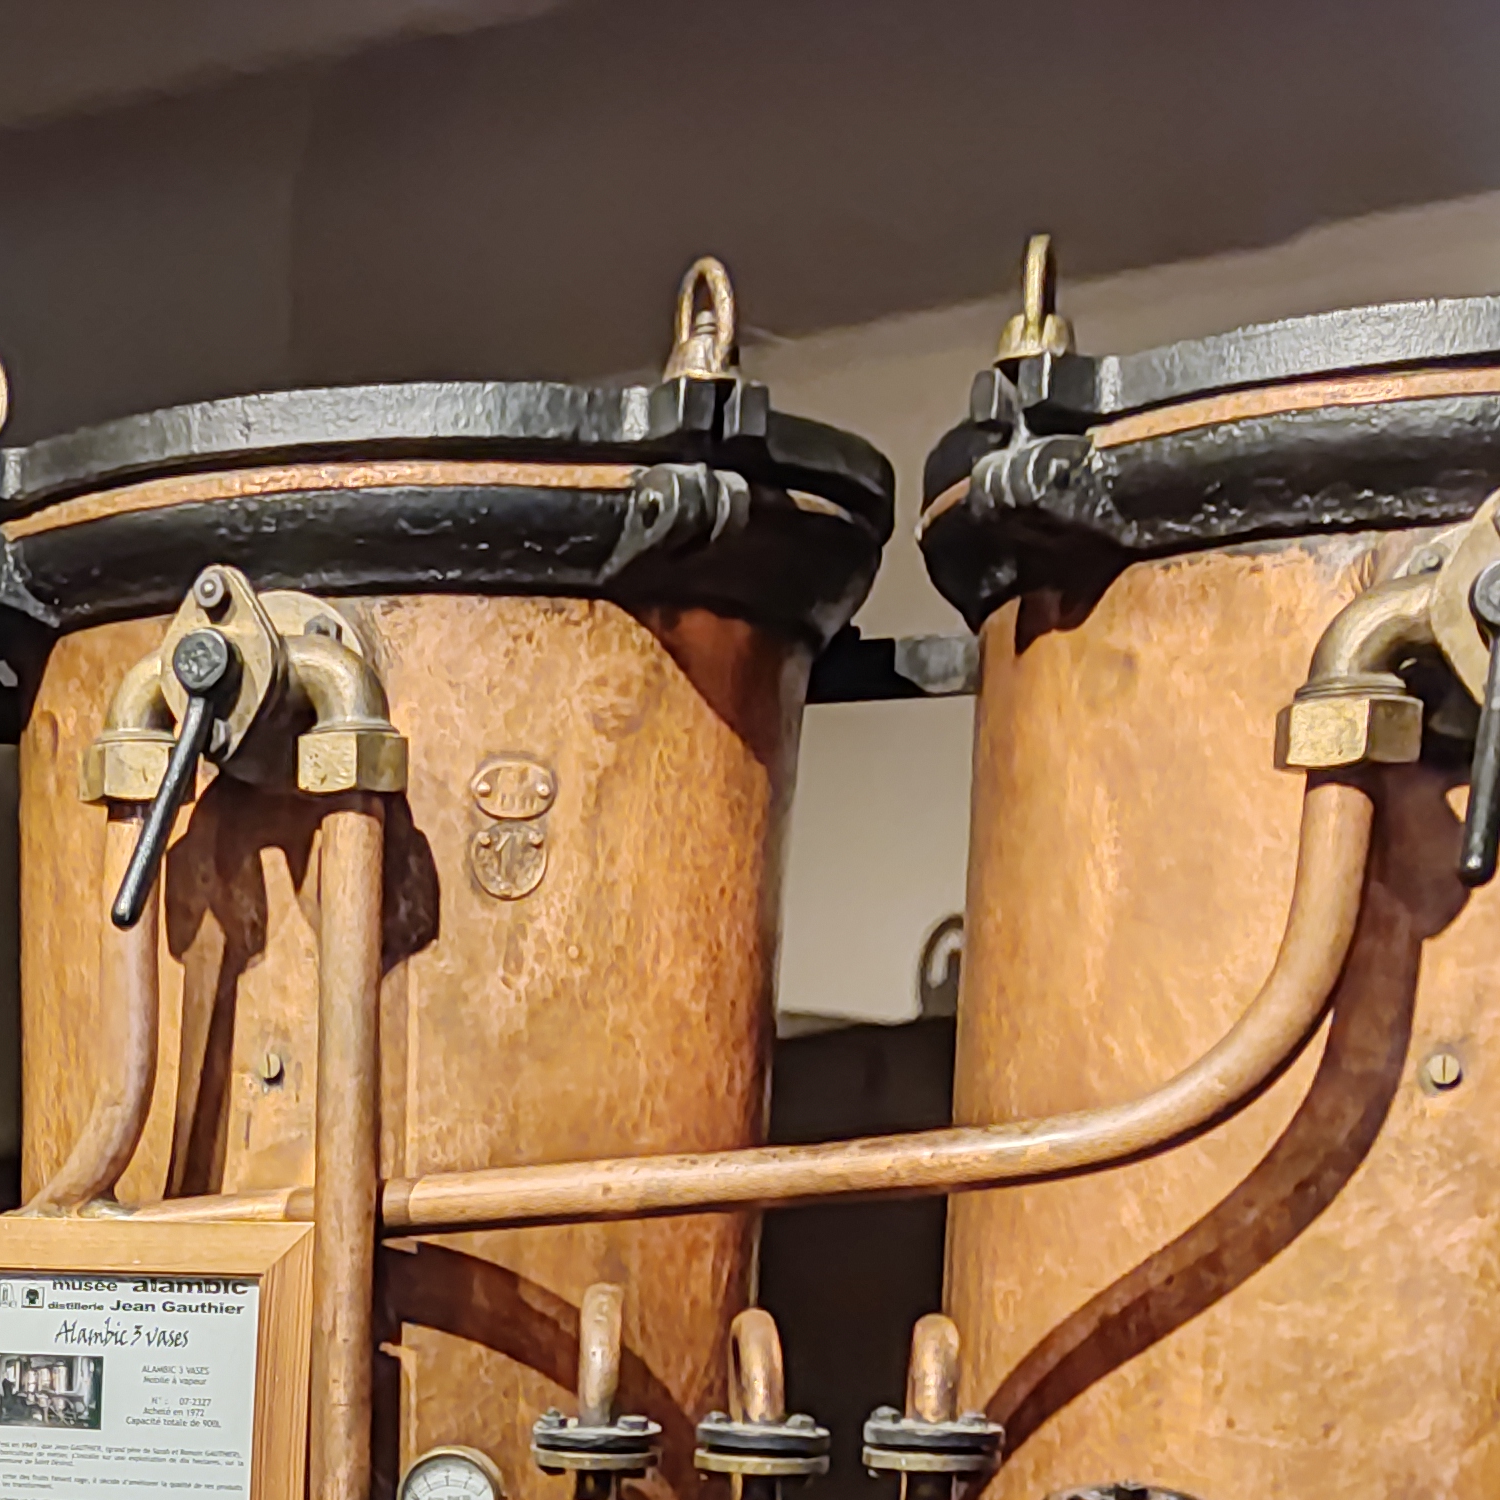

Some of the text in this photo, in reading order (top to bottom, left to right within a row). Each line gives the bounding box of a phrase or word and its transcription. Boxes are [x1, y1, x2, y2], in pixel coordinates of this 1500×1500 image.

[132, 1278, 249, 1295] alambic
[47, 1300, 246, 1315] distillerie Jean Gauthier
[54, 1316, 128, 1347] Alambic
[130, 1325, 143, 1346] 3
[141, 1365, 176, 1374] ALAMBIC
[186, 1366, 210, 1375] VASES
[126, 1416, 161, 1426] Capacité
[163, 1417, 188, 1427] totale
[190, 1418, 201, 1427] de
